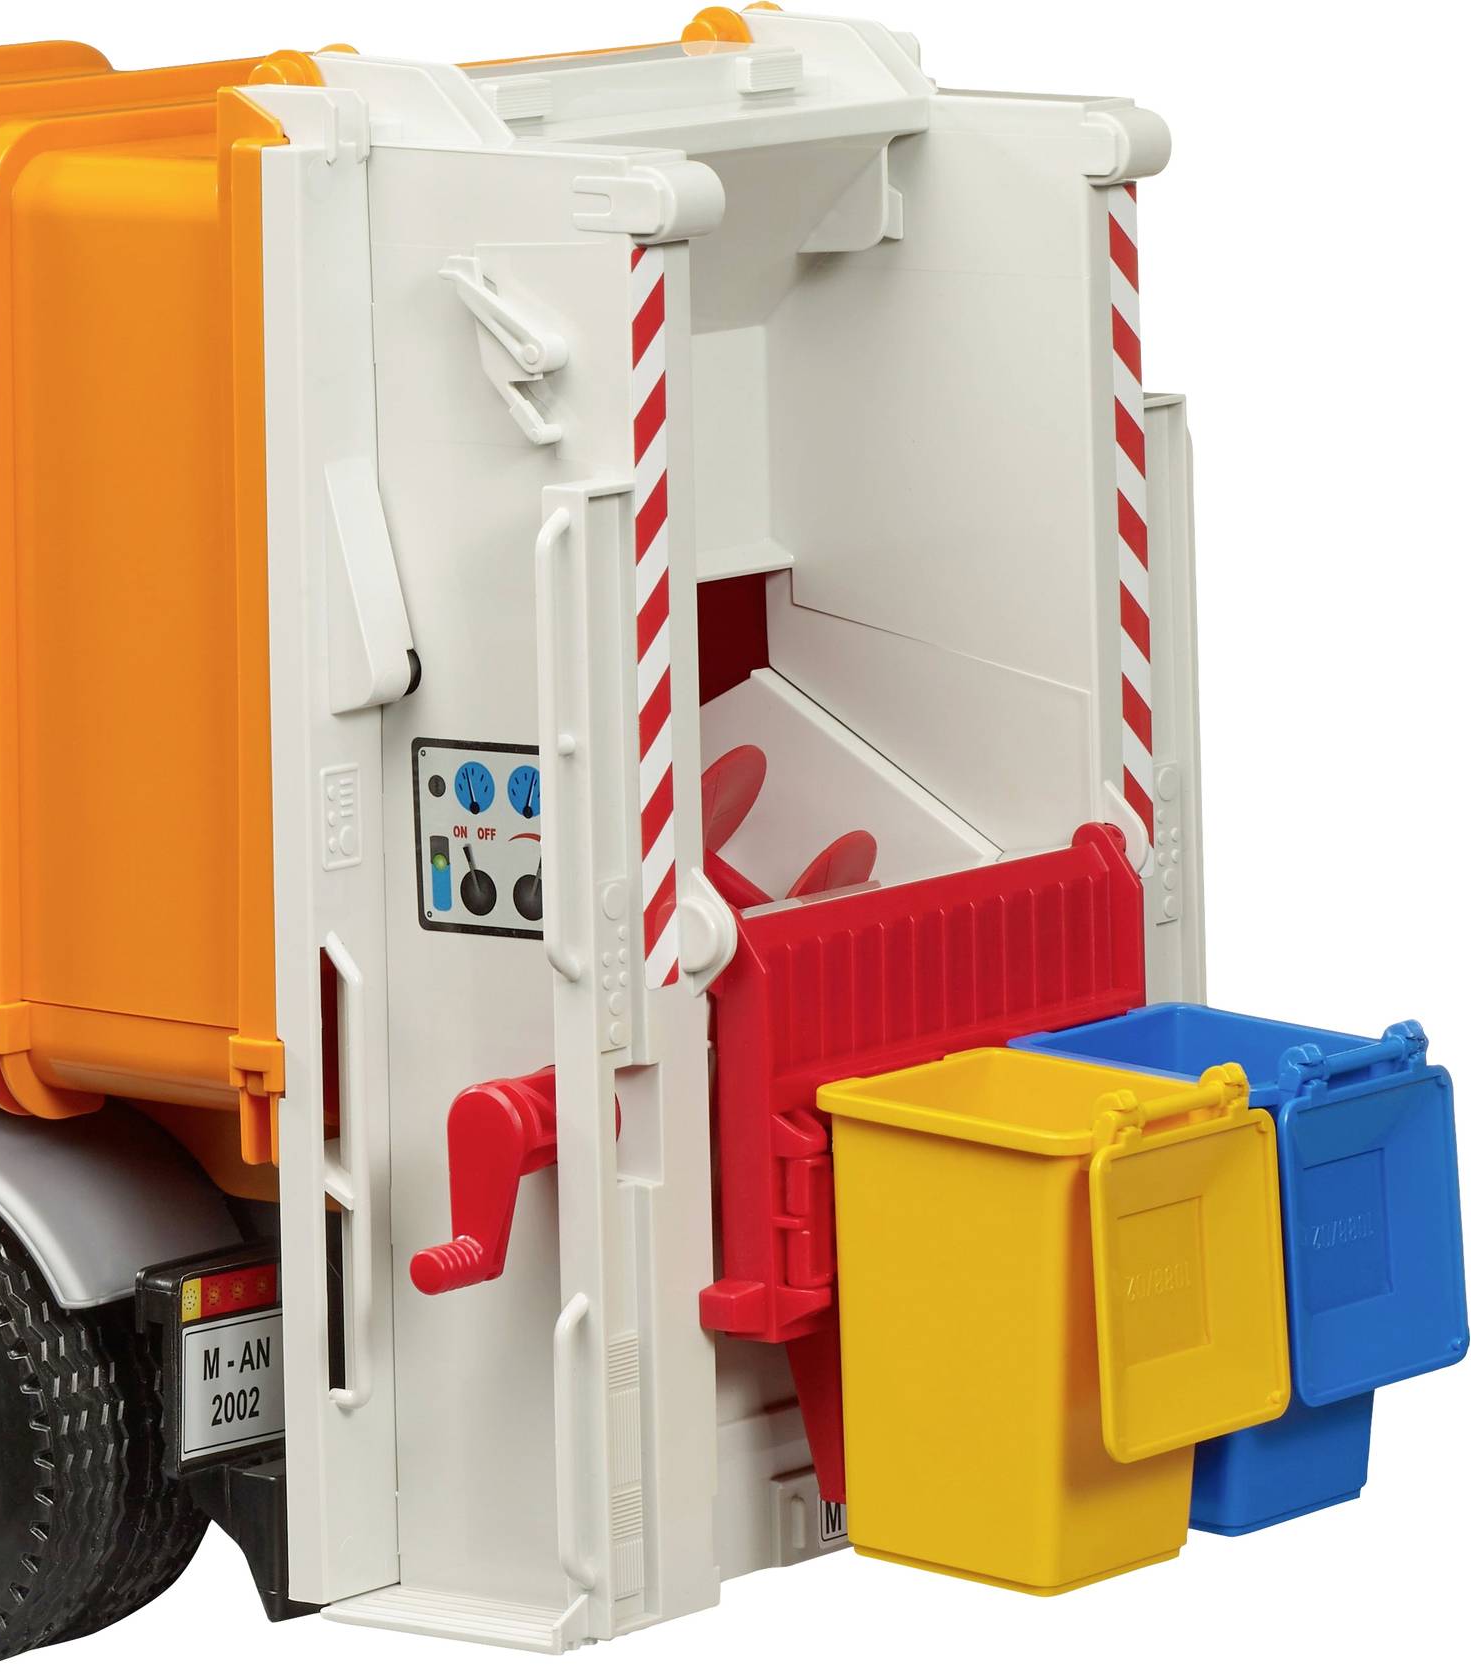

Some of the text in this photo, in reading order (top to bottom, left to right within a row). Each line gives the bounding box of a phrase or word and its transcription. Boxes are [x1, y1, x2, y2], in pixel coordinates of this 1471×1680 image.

[453, 825, 497, 841] ON OFF
[203, 1347, 220, 1381] M
[239, 1336, 271, 1373] AN
[211, 1386, 260, 1427] 2002
[825, 1501, 842, 1534] M
